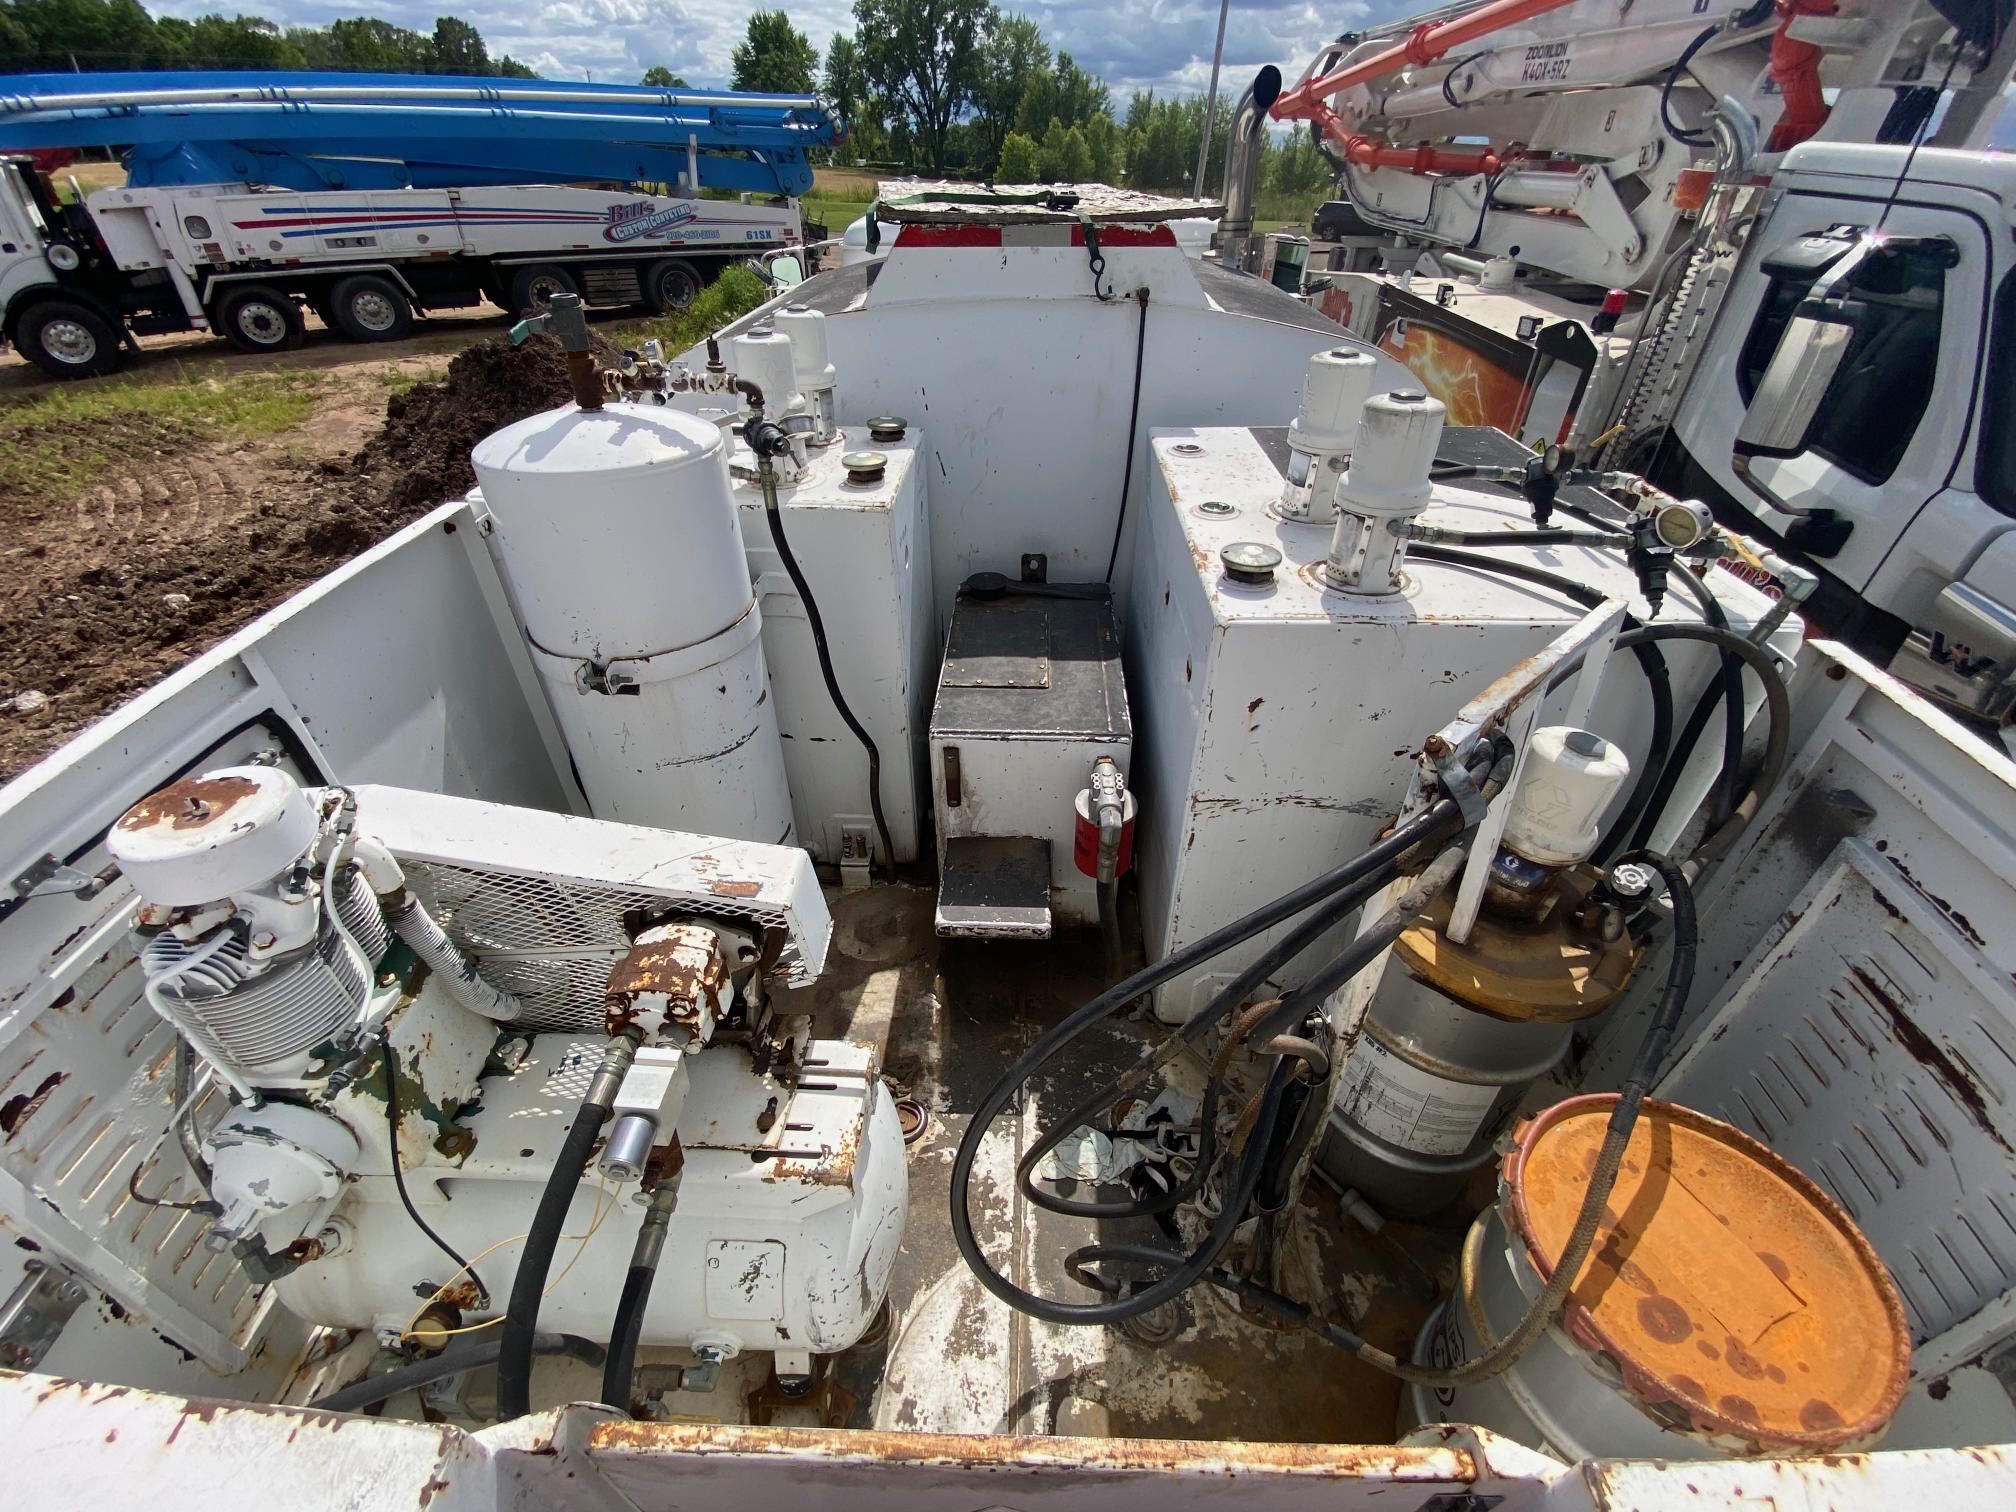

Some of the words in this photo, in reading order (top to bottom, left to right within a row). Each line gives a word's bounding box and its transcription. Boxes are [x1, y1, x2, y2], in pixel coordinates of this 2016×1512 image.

[1525, 42, 1569, 60] ZOOMLION
[650, 204, 691, 227] CONVEYING
[746, 230, 772, 240] 61SX
